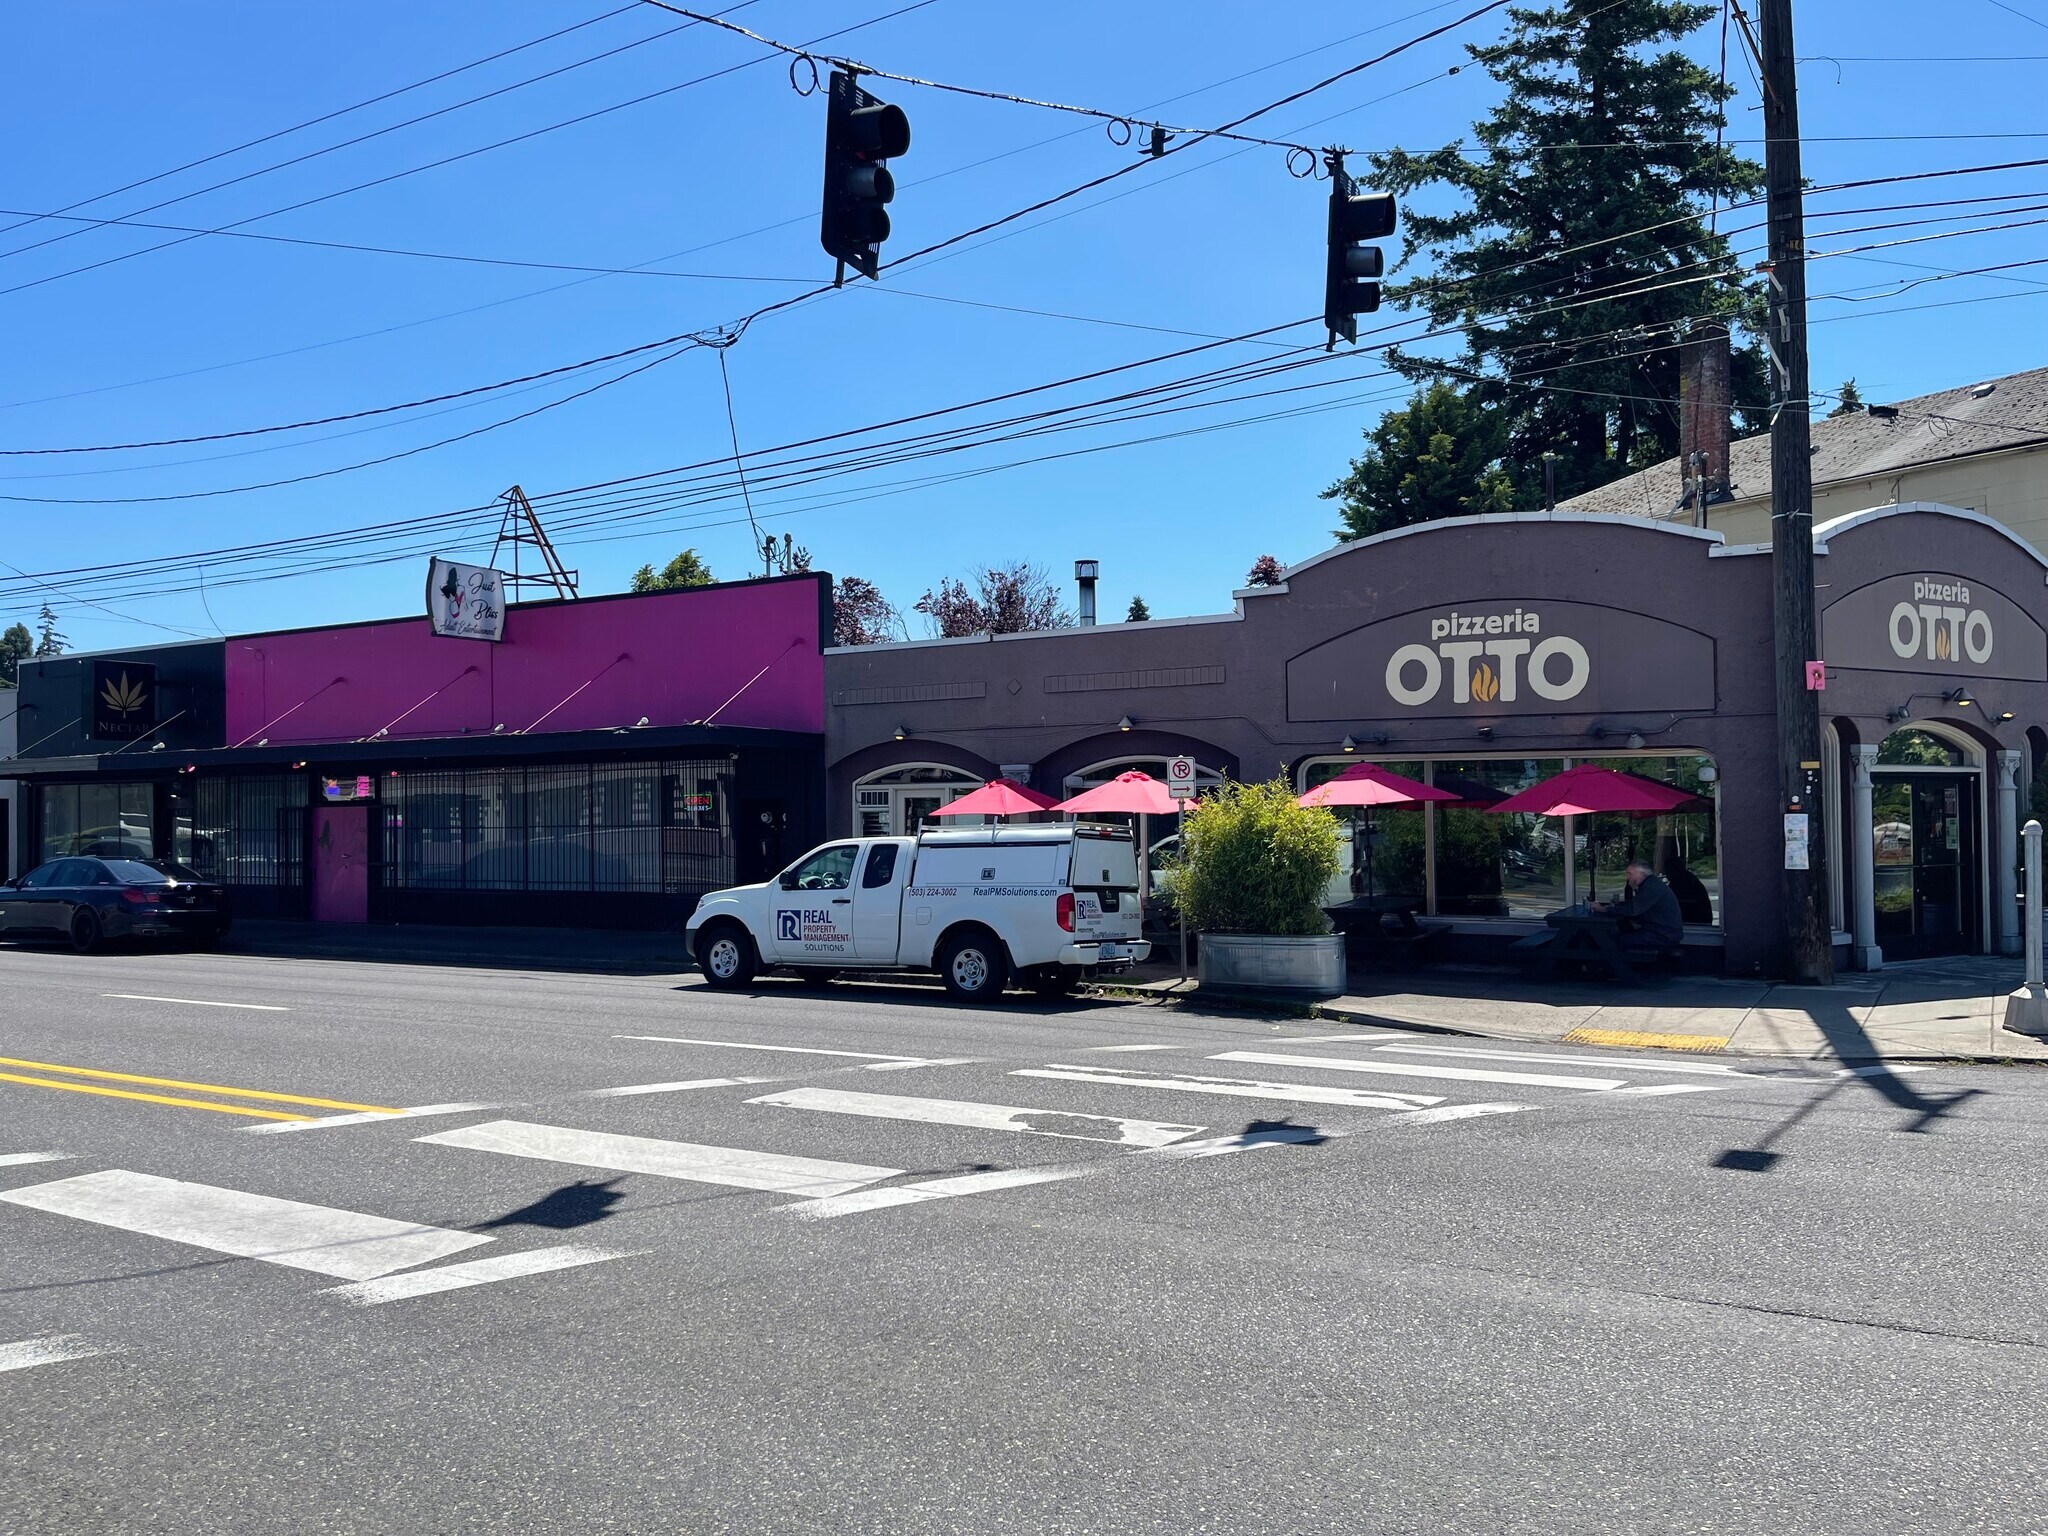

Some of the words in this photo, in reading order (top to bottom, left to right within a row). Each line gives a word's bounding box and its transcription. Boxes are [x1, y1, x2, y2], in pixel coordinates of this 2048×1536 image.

[468, 572, 495, 594] Just
[1914, 577, 1970, 605] pizzeria
[470, 598, 499, 620] Bliss
[1431, 608, 1541, 641] pizzeria
[1888, 601, 1994, 665] OTTO
[1385, 635, 1590, 706] OTTO
[684, 796, 710, 806] OPEN
[908, 888, 926, 898] (503)
[926, 888, 957, 897] 224-3002
[973, 887, 1058, 897] RealPMSolutions.com
[803, 909, 832, 923] REAL
[803, 924, 836, 934] PROPERTY
[803, 933, 849, 942] MANAGEMENT
[804, 943, 845, 952] SOLUTIONS
